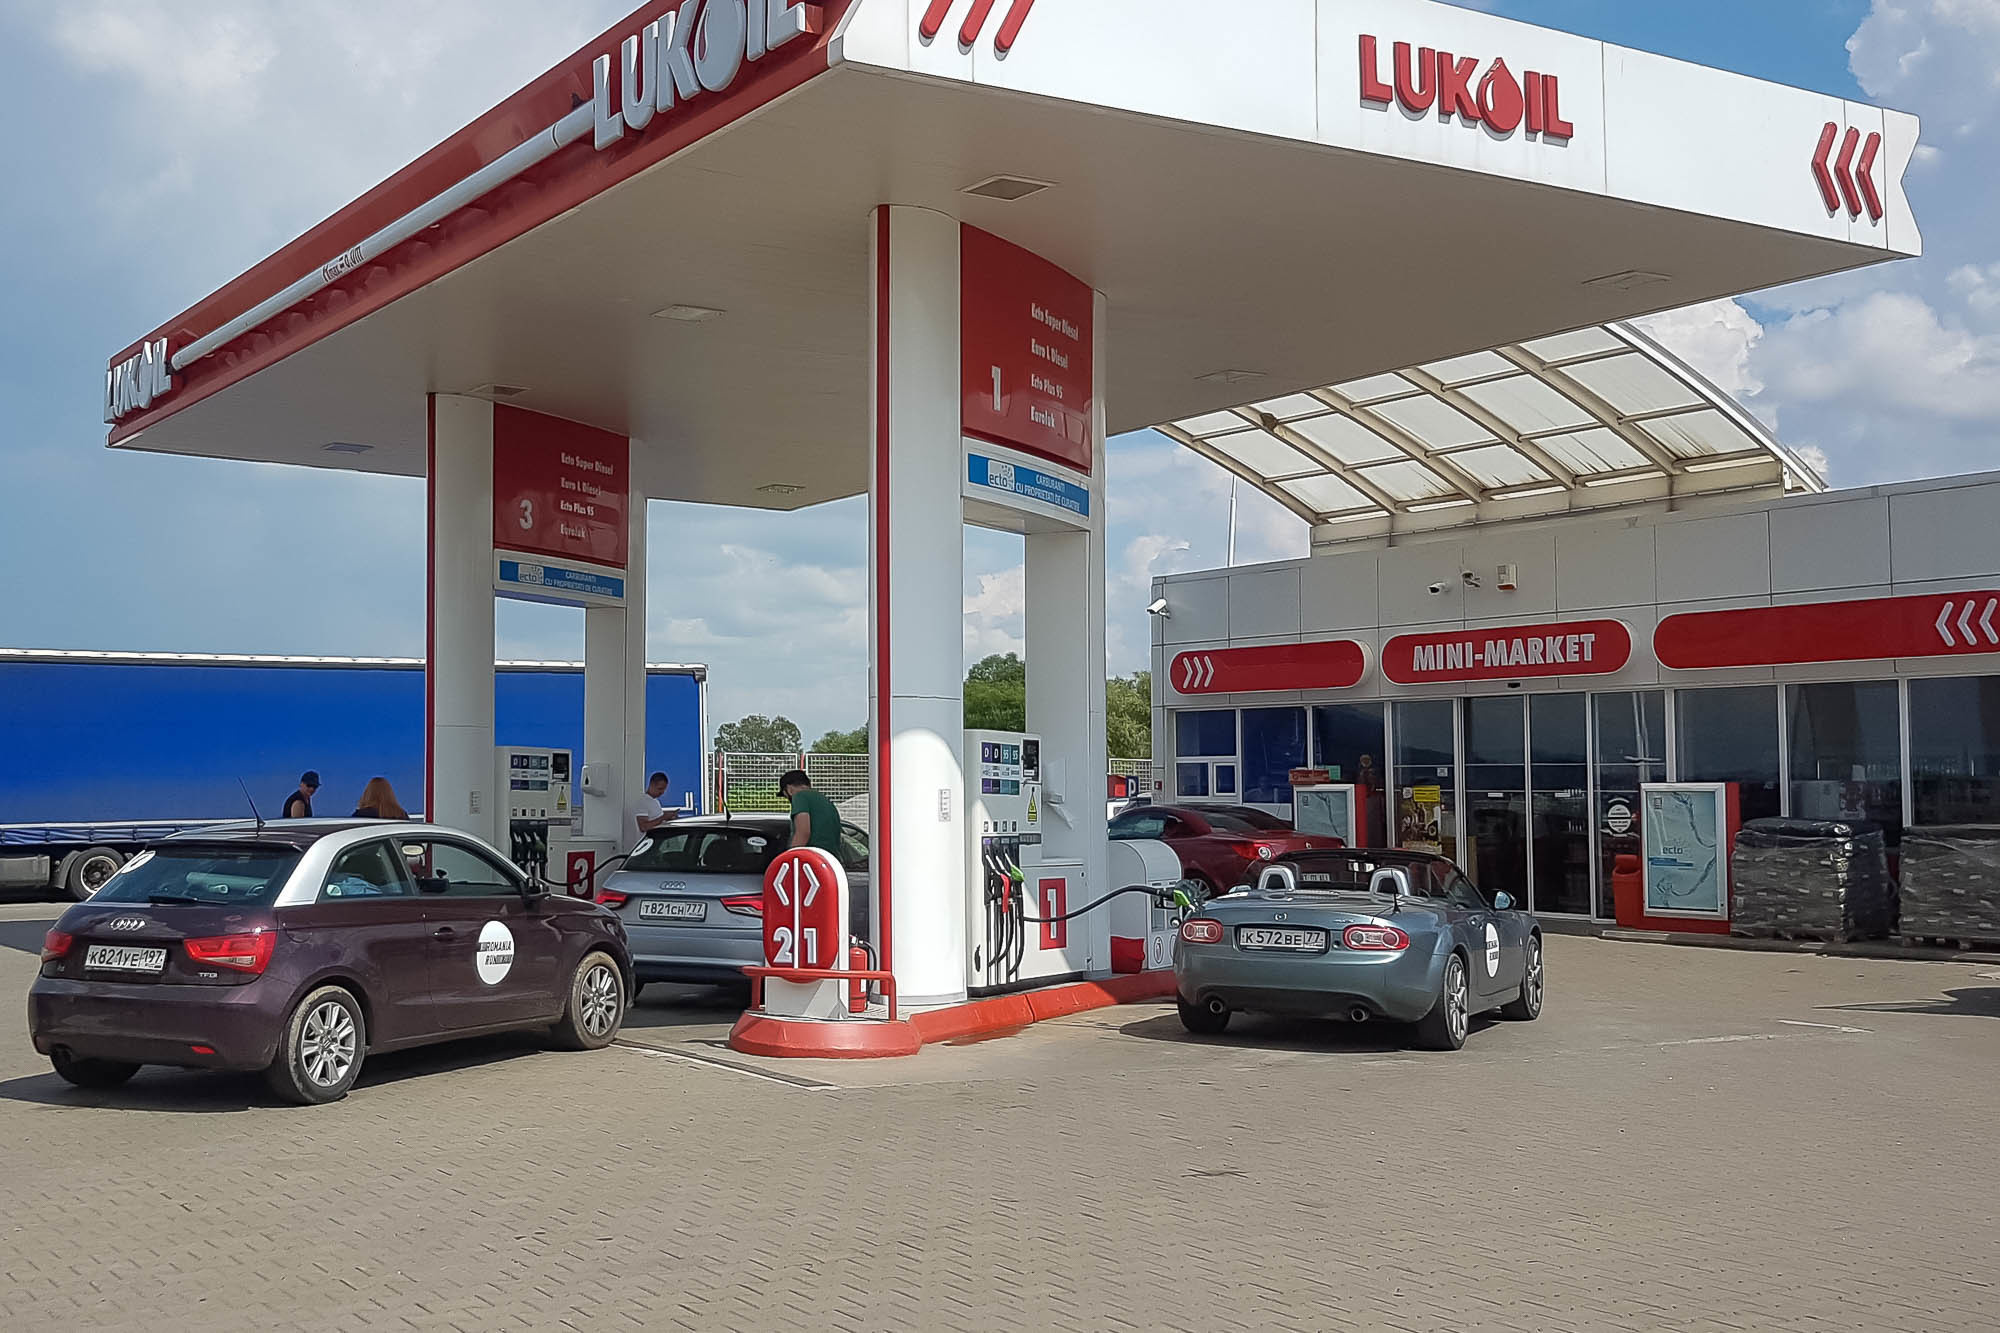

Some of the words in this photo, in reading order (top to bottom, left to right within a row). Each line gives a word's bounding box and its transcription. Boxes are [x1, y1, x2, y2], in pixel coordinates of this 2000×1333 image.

[1359, 34, 1573, 139] LUKOIL
[103, 337, 171, 421] LUKOIL
[991, 365, 1001, 412] 1
[989, 472, 1008, 487] ecto
[519, 499, 533, 530] 3
[520, 573, 536, 583] ecto
[1413, 633, 1596, 672] MINI-MARKET
[1128, 778, 1136, 797] P
[1662, 846, 1683, 855] ecto
[573, 858, 589, 895] 3
[1047, 888, 1057, 939] 1
[773, 926, 793, 963] 2
[803, 927, 817, 964] 1
[1306, 931, 1321, 943] 77
[143, 949, 163, 964] 197
